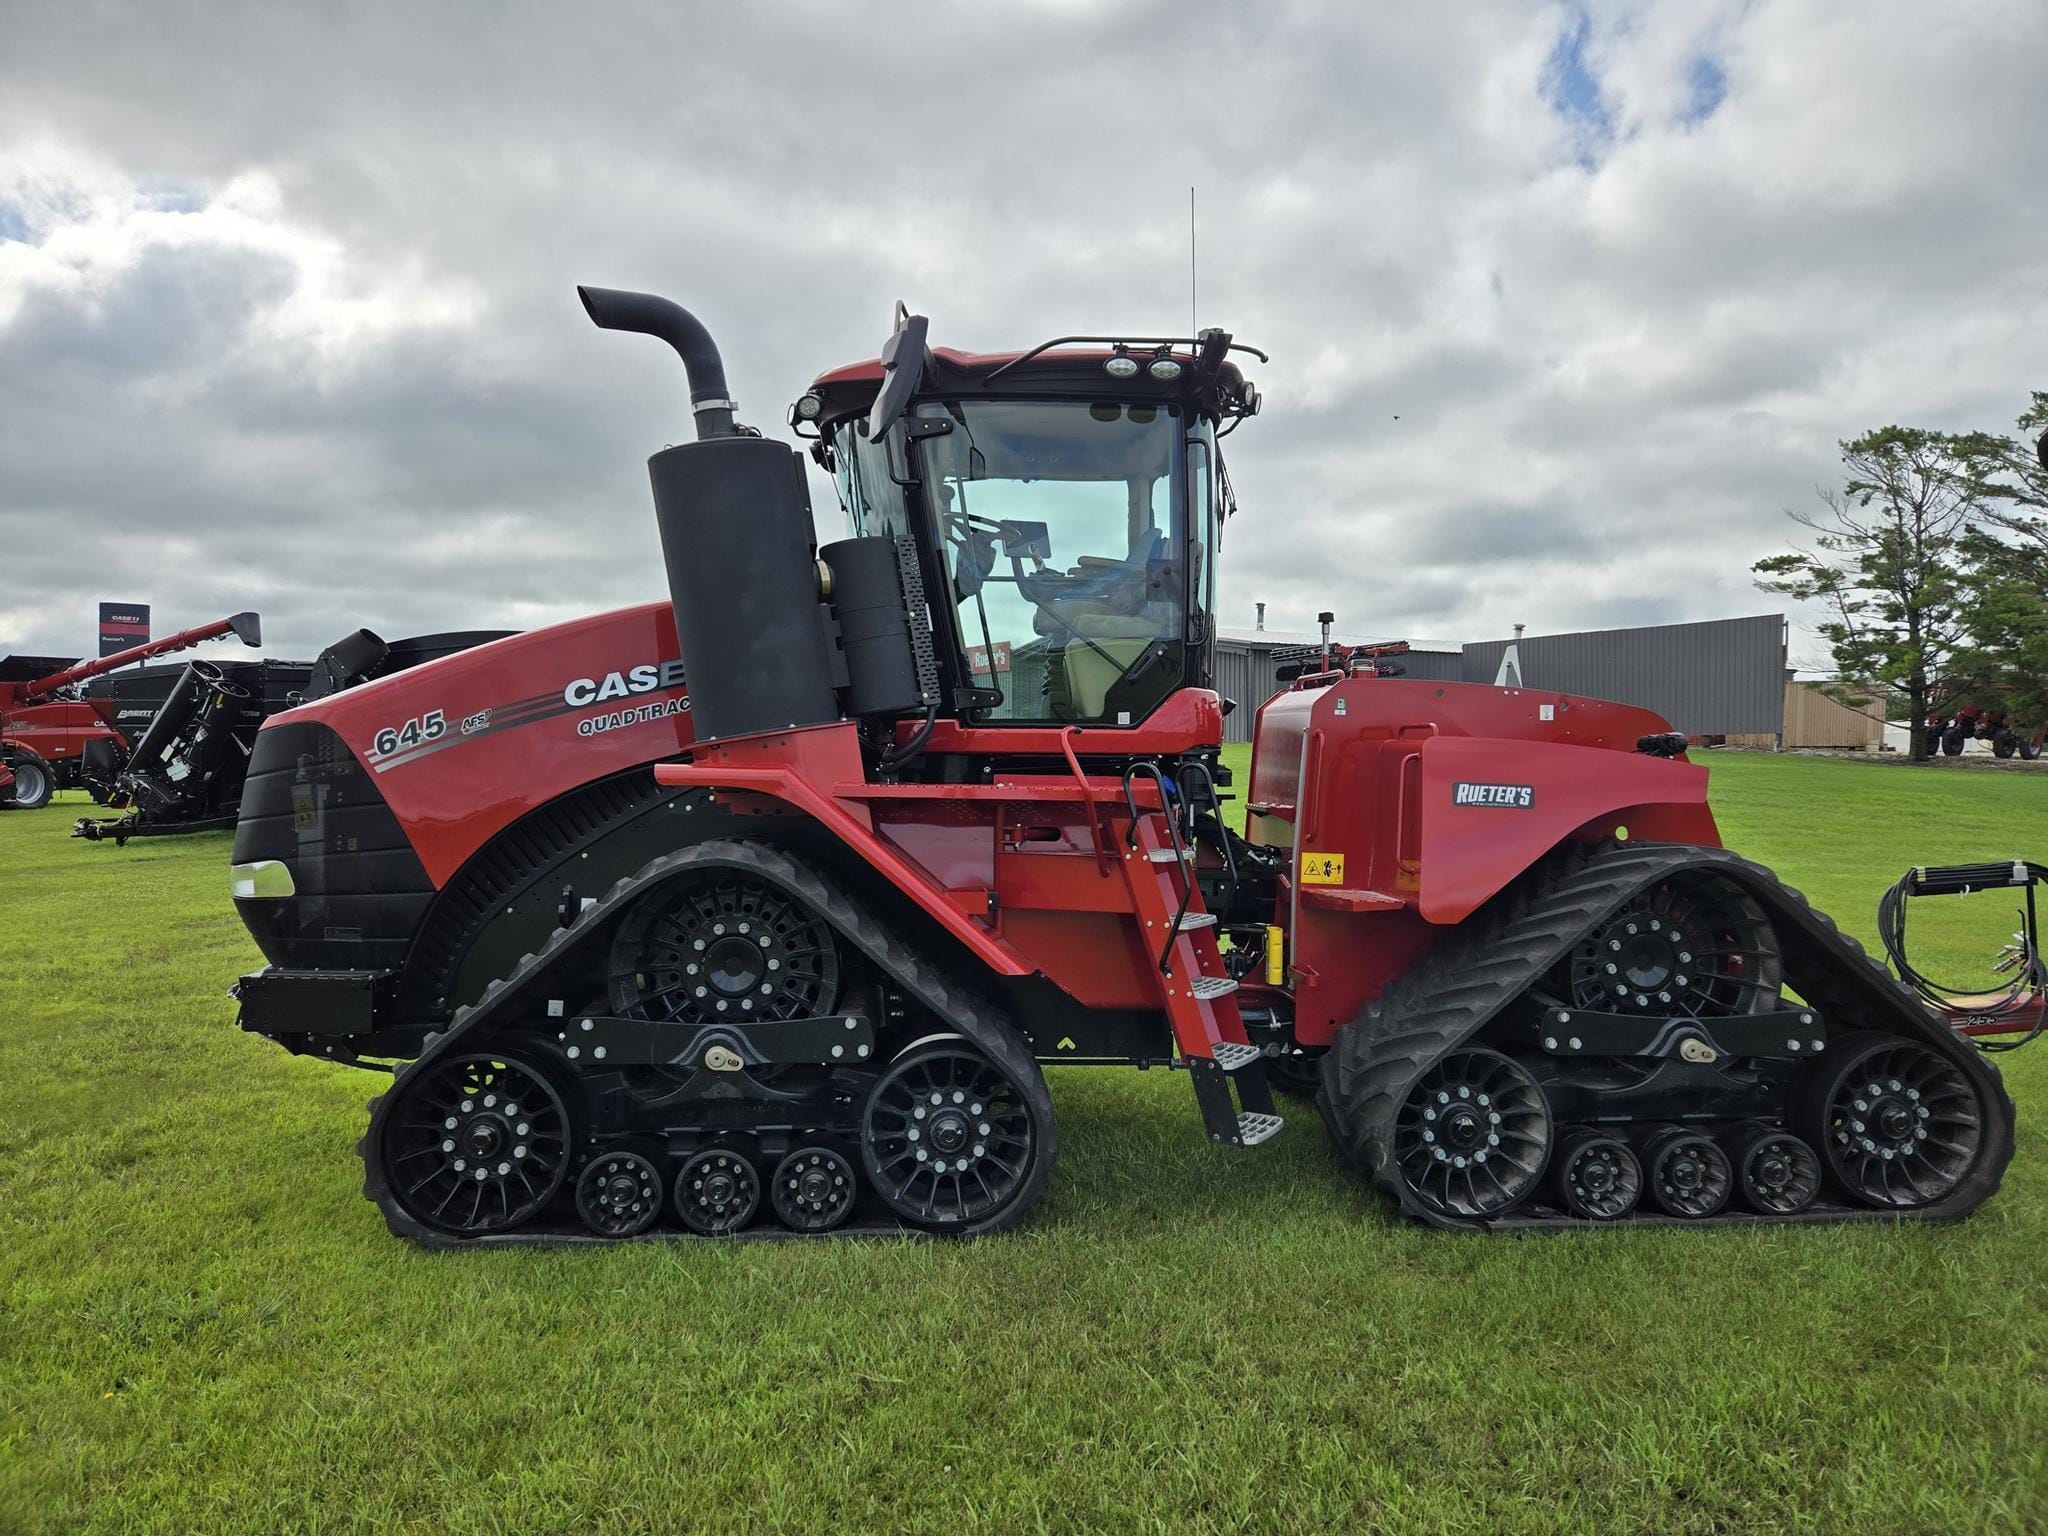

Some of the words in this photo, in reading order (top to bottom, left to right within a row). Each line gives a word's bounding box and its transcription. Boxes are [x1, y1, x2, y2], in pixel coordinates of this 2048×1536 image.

[564, 659, 685, 707] CASE
[374, 708, 447, 756] 645
[461, 710, 489, 733] AFS
[577, 695, 691, 736] QUADTRAC
[1456, 783, 1532, 806] RUETER'S
